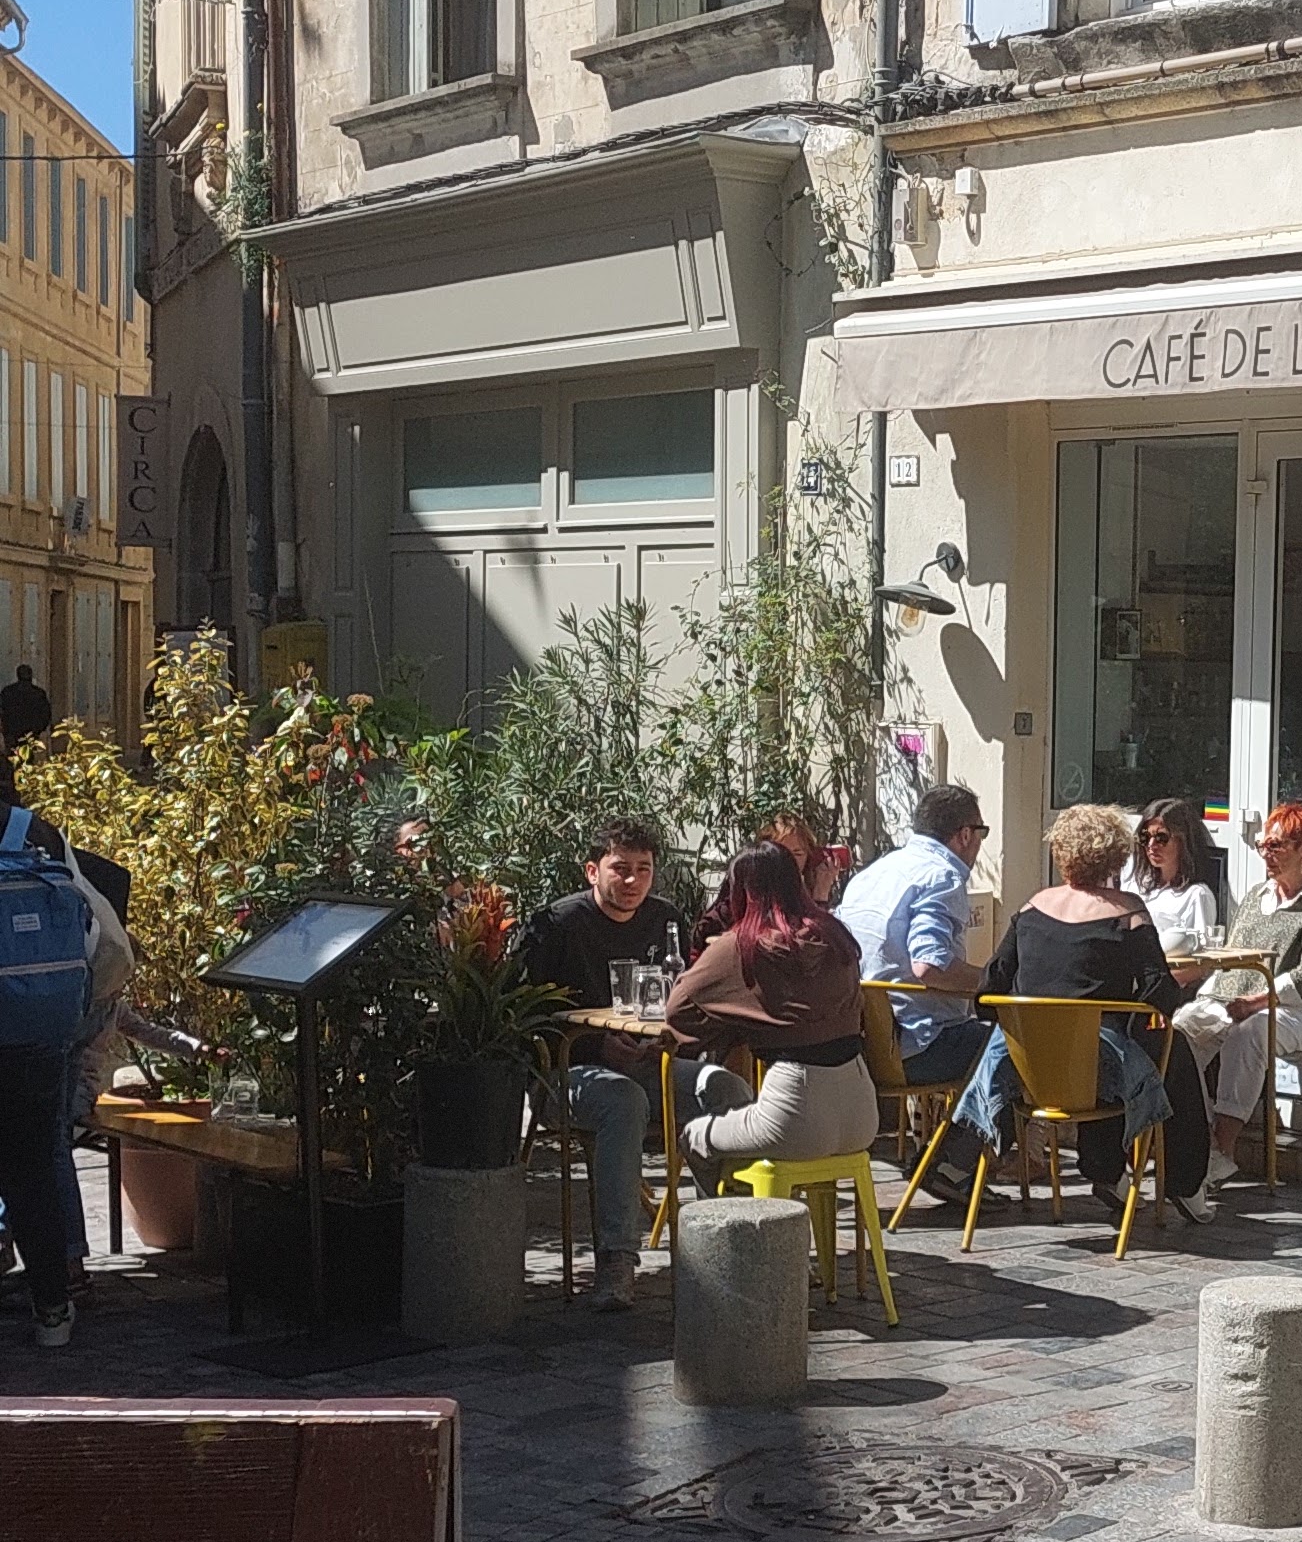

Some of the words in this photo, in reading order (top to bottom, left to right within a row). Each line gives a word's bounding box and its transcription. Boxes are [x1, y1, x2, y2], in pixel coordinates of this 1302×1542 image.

[1102, 318, 1207, 389] CAFÉ
[1220, 325, 1273, 379] DE
[127, 405, 158, 540] CIRCA
[895, 461, 913, 478] 12
